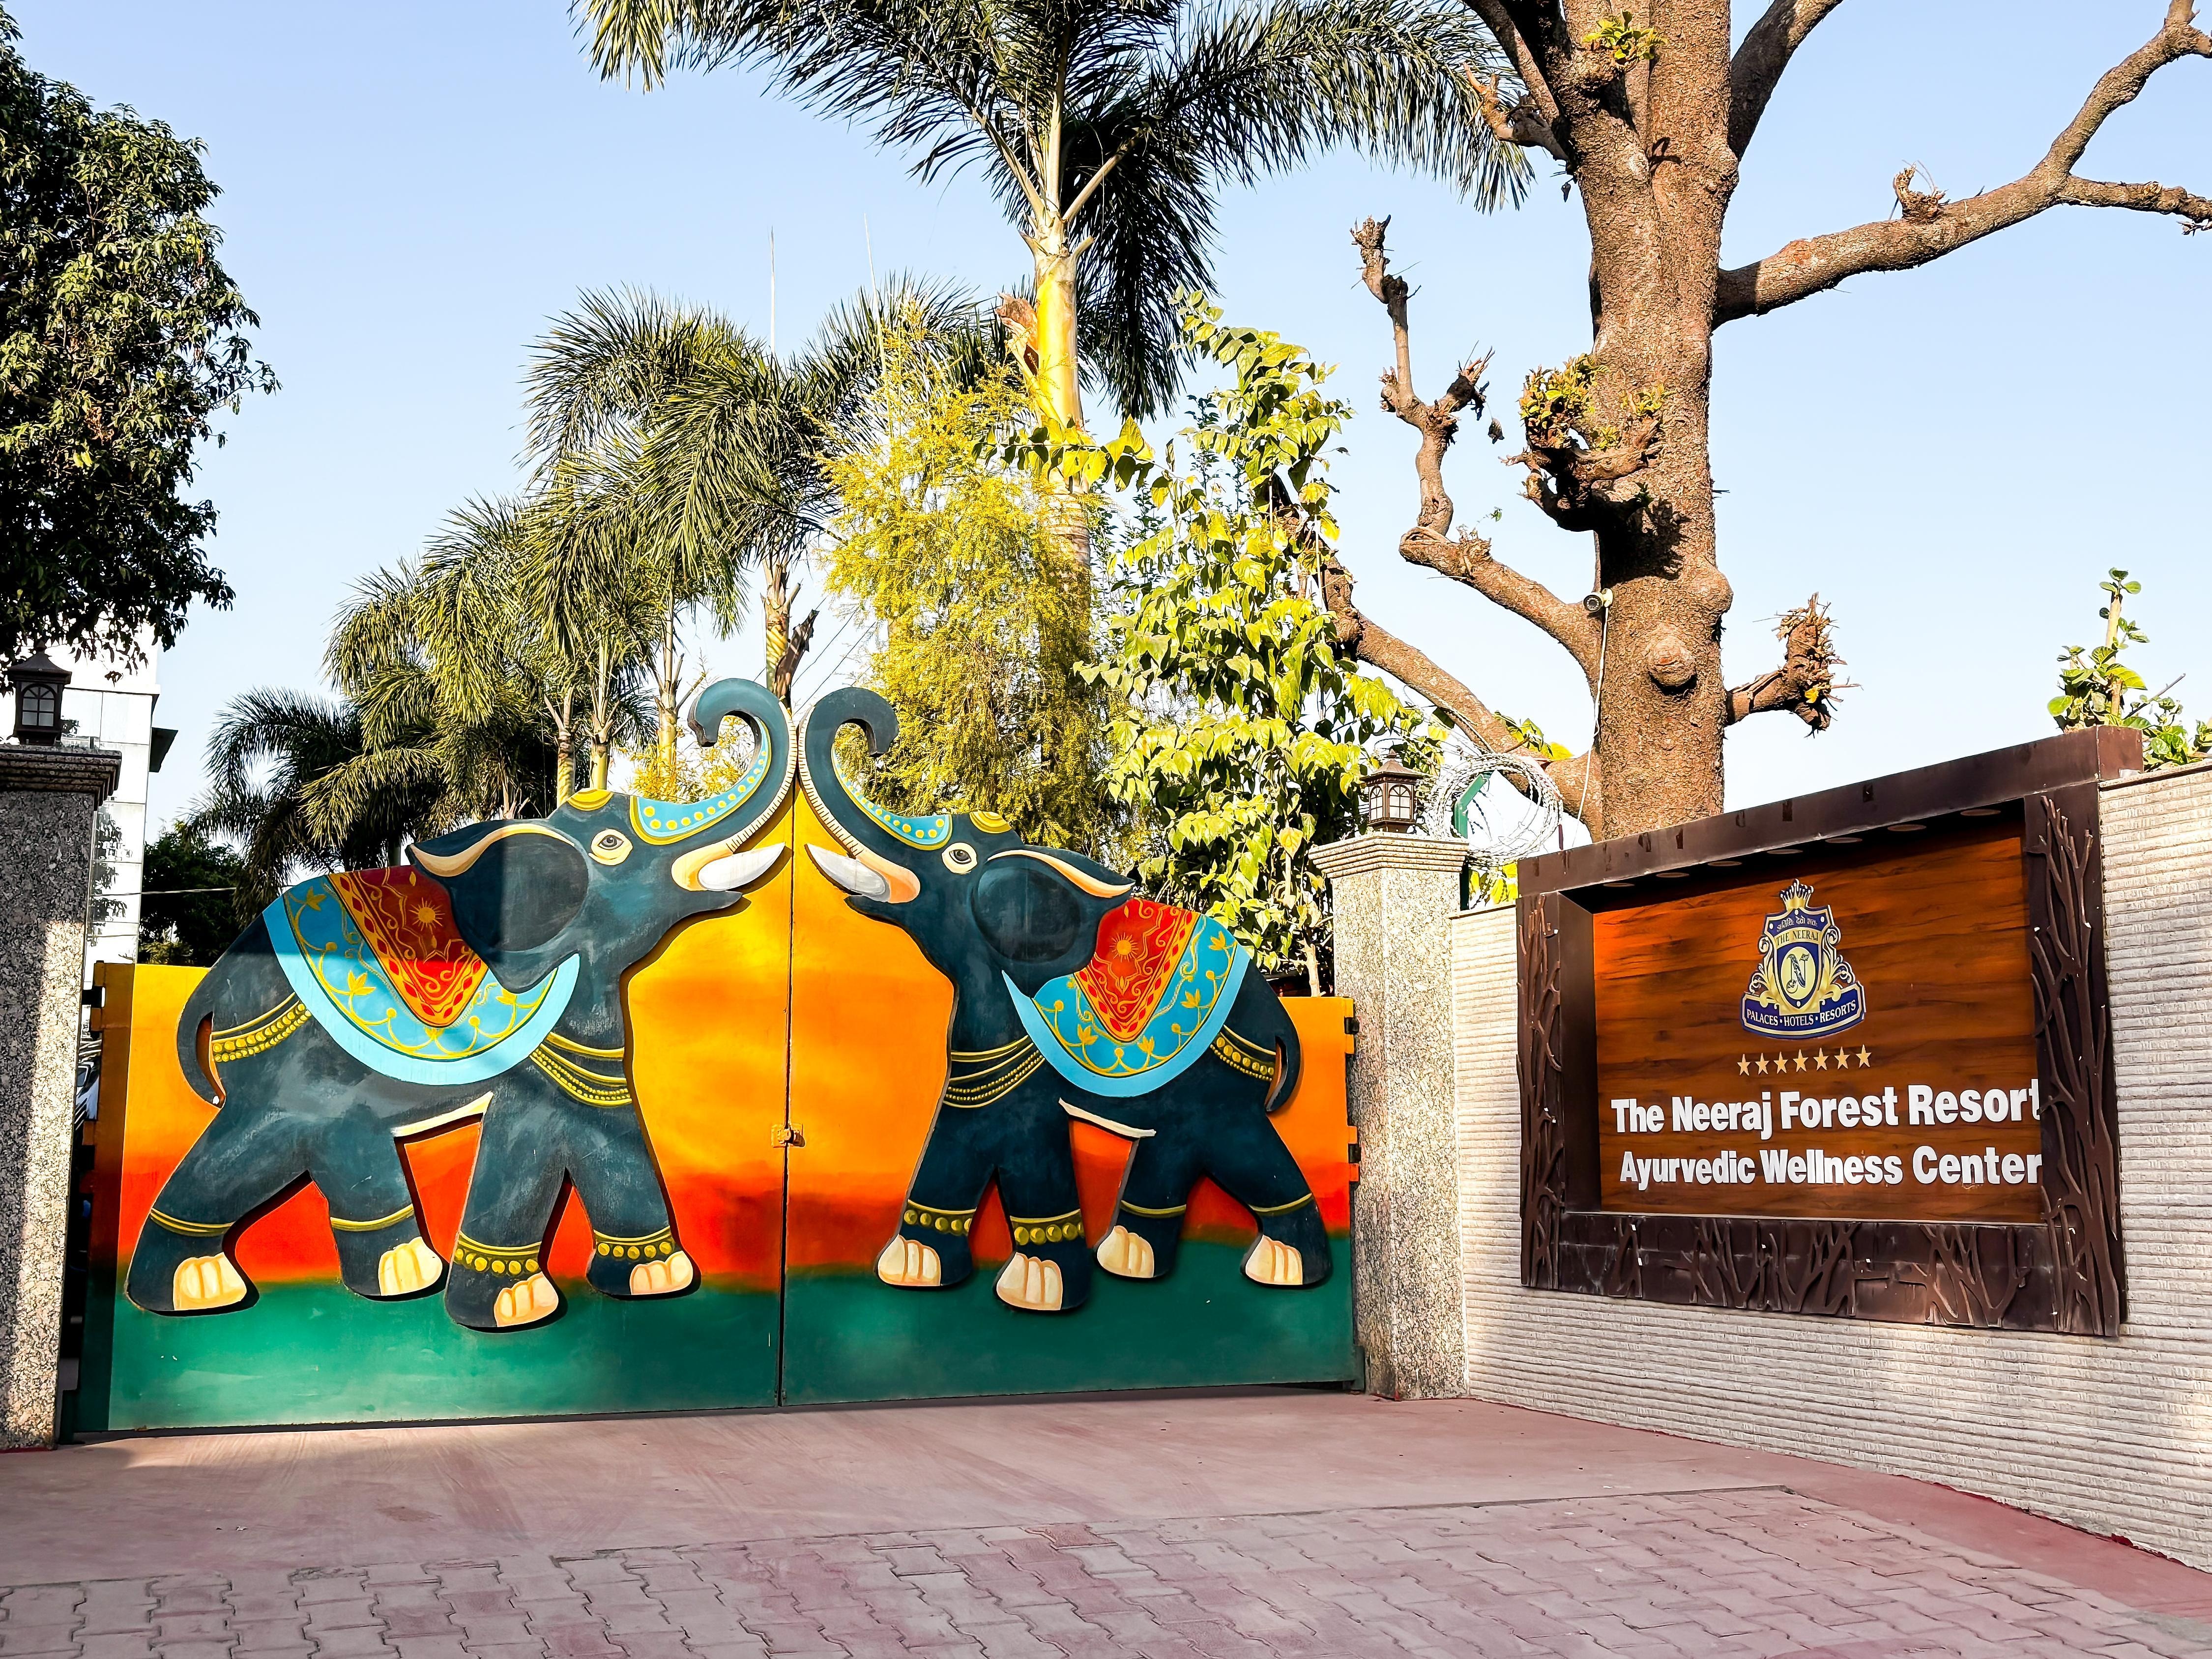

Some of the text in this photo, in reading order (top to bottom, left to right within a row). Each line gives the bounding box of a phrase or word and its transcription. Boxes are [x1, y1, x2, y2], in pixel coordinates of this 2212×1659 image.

[1776, 930, 1818, 946] THE NEERAJ
[1786, 954, 1809, 993] N
[1746, 999, 1856, 1026] PALACES HOTELS RESORTS
[1611, 1078, 2040, 1140] The Neeraj Forest Resort
[1620, 1145, 2042, 1191] Ayurvedic Wellness Center
